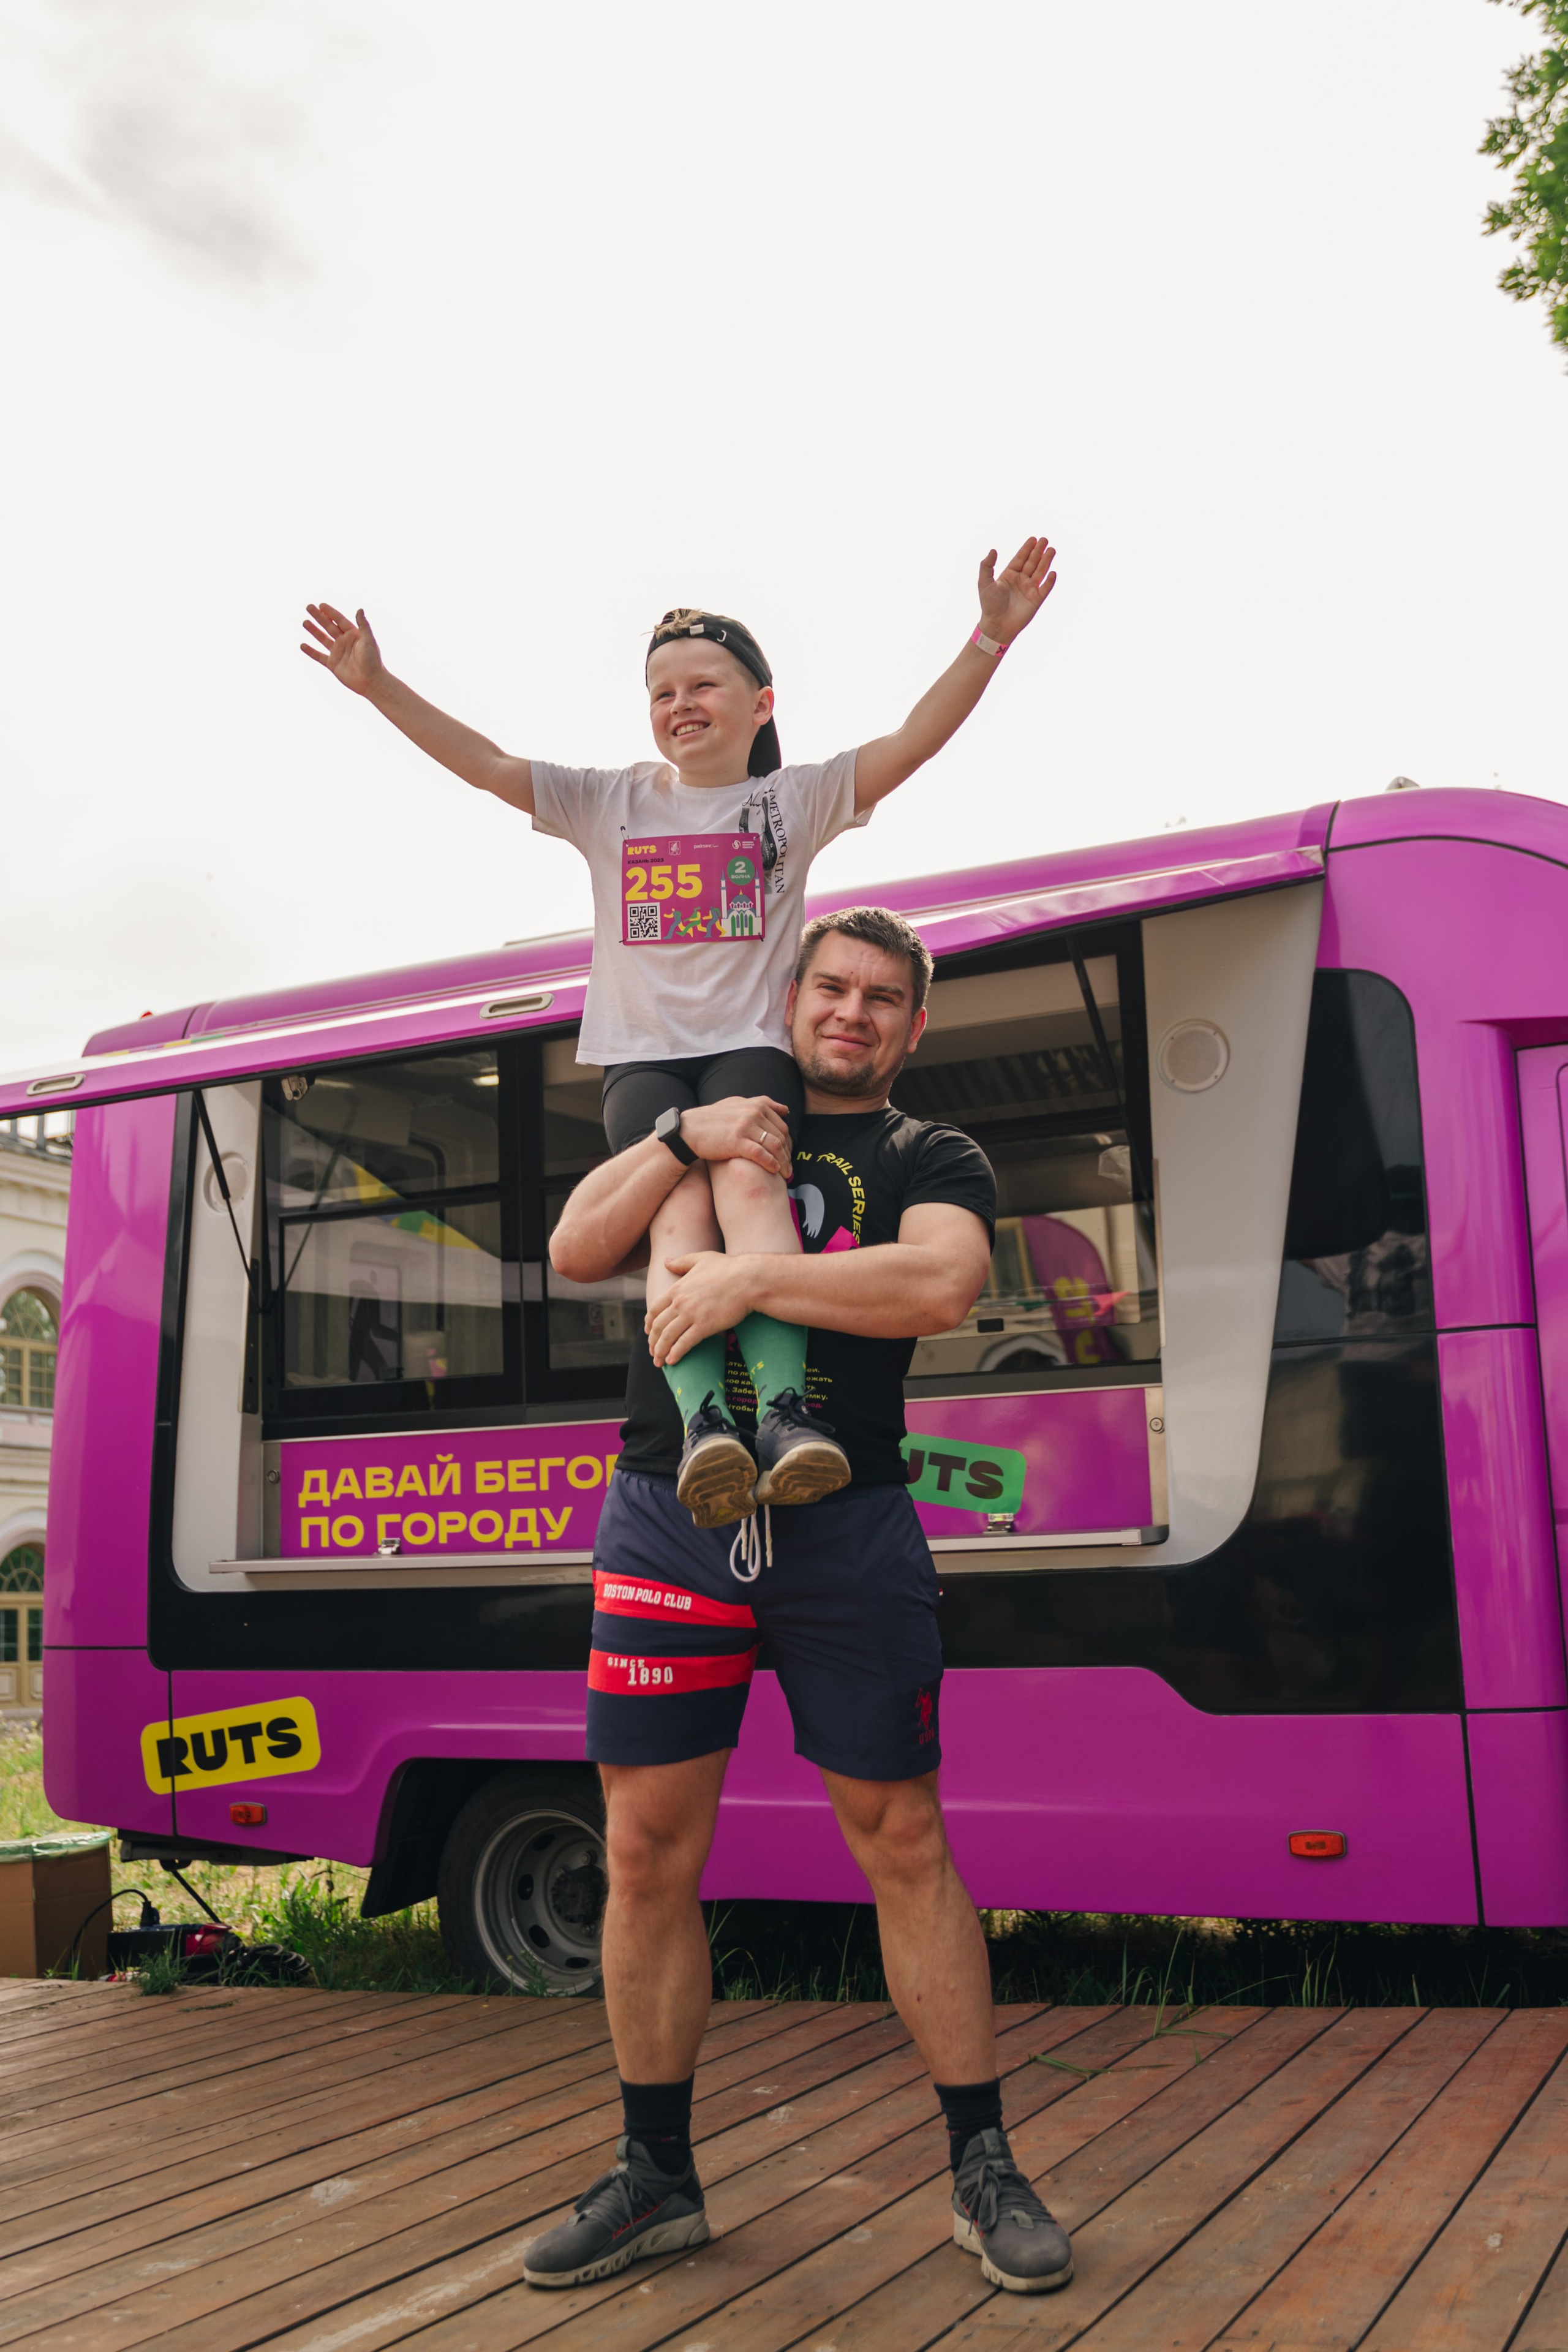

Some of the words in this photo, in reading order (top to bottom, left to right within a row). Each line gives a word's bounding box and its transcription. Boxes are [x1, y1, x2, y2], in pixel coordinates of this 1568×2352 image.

[627, 845, 657, 855] RUTS
[770, 794, 788, 894] METROPOLITAN
[625, 864, 703, 901] 255
[734, 861, 747, 873] 2
[816, 1152, 853, 1175] TRAIL
[848, 1176, 865, 1245] SERIES
[298, 1453, 461, 1507] ДАВАЙ
[300, 1515, 364, 1548] ПО
[376, 1506, 573, 1549] ГОРОДУ
[603, 1583, 636, 1600] BOSTON
[635, 1588, 662, 1605] POLO
[664, 1593, 692, 1611] CLUB
[607, 1656, 646, 1668] SINCE
[627, 1666, 674, 1686] 1890
[156, 1716, 303, 1778] RUTS
